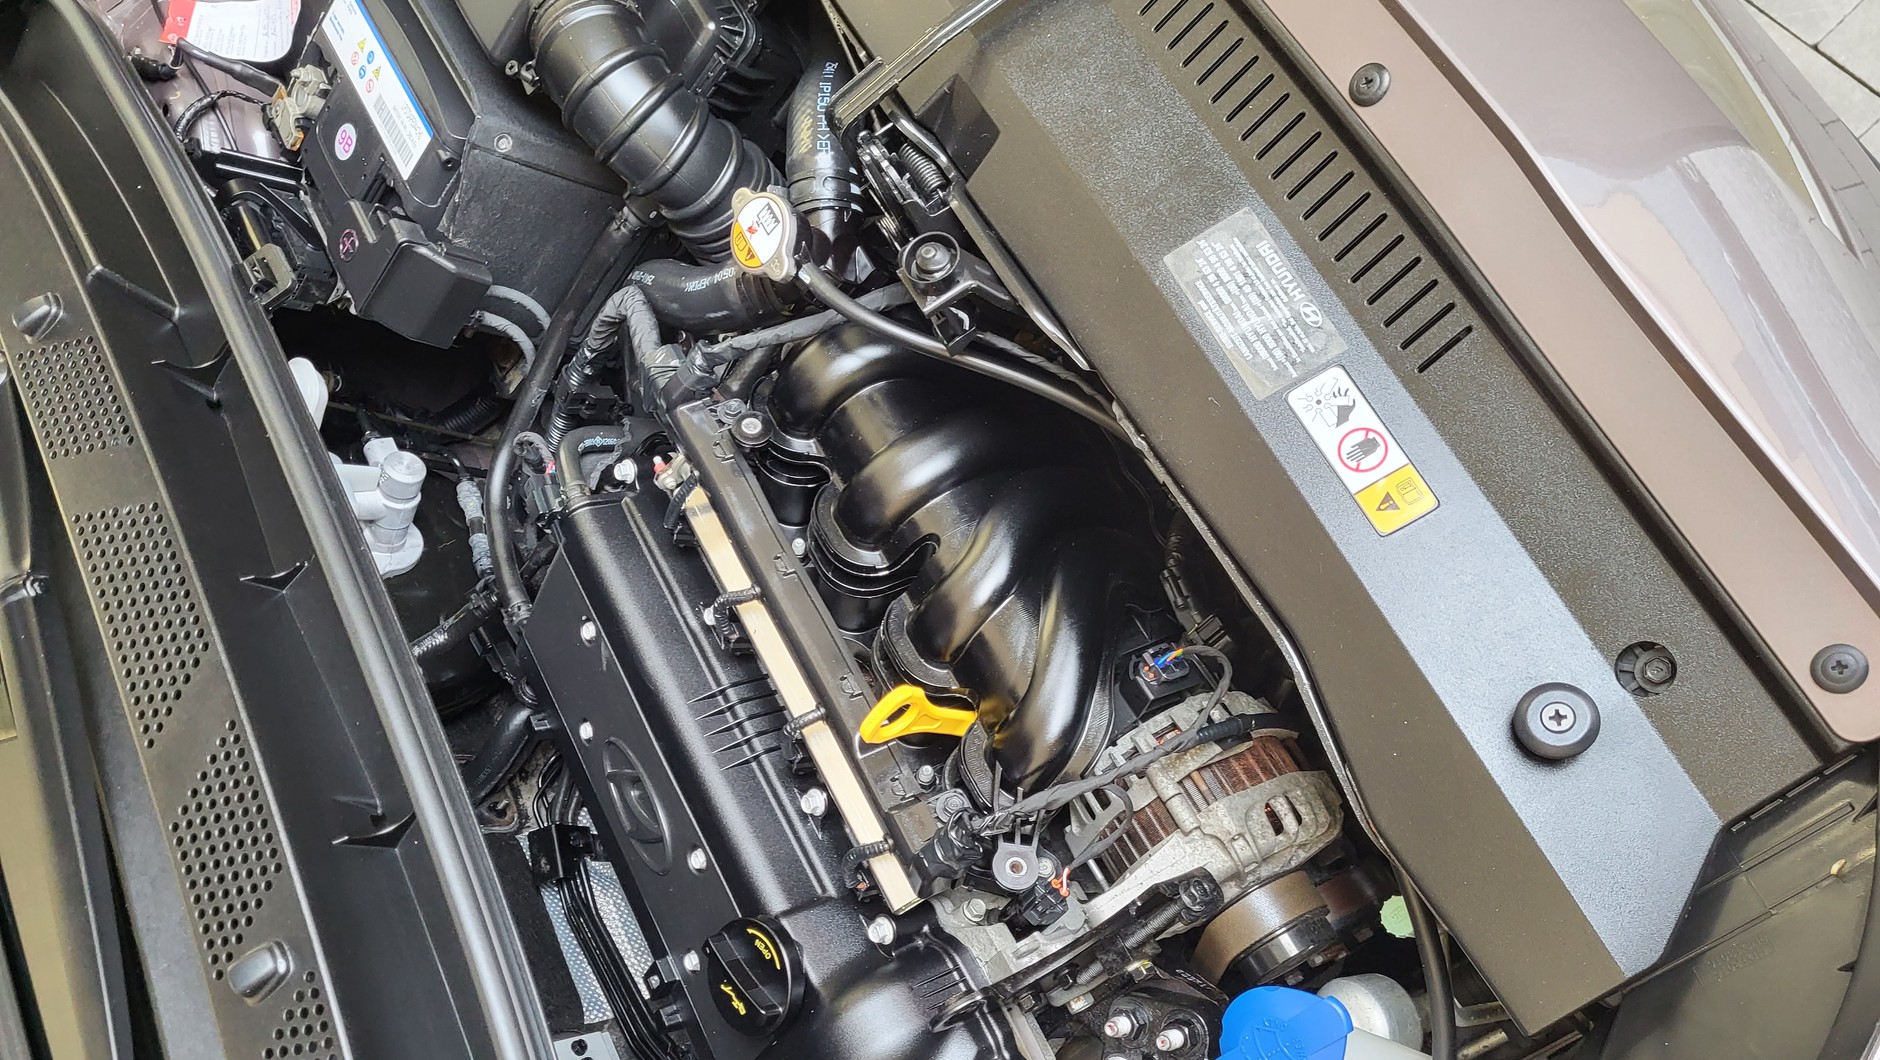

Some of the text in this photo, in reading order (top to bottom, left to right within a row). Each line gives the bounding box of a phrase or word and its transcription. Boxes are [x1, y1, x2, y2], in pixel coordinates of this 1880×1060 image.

[1256, 240, 1305, 301] HYUNDAI
[1215, 286, 1232, 305] 08000
[1204, 310, 1234, 349] EURO-SERVICE
[1232, 310, 1258, 342] HYUNDAI
[1241, 303, 1267, 335] HYUNDAI
[1253, 341, 1270, 360] 08000
[1262, 333, 1277, 349] 8000
[754, 939, 771, 960] OPEN
